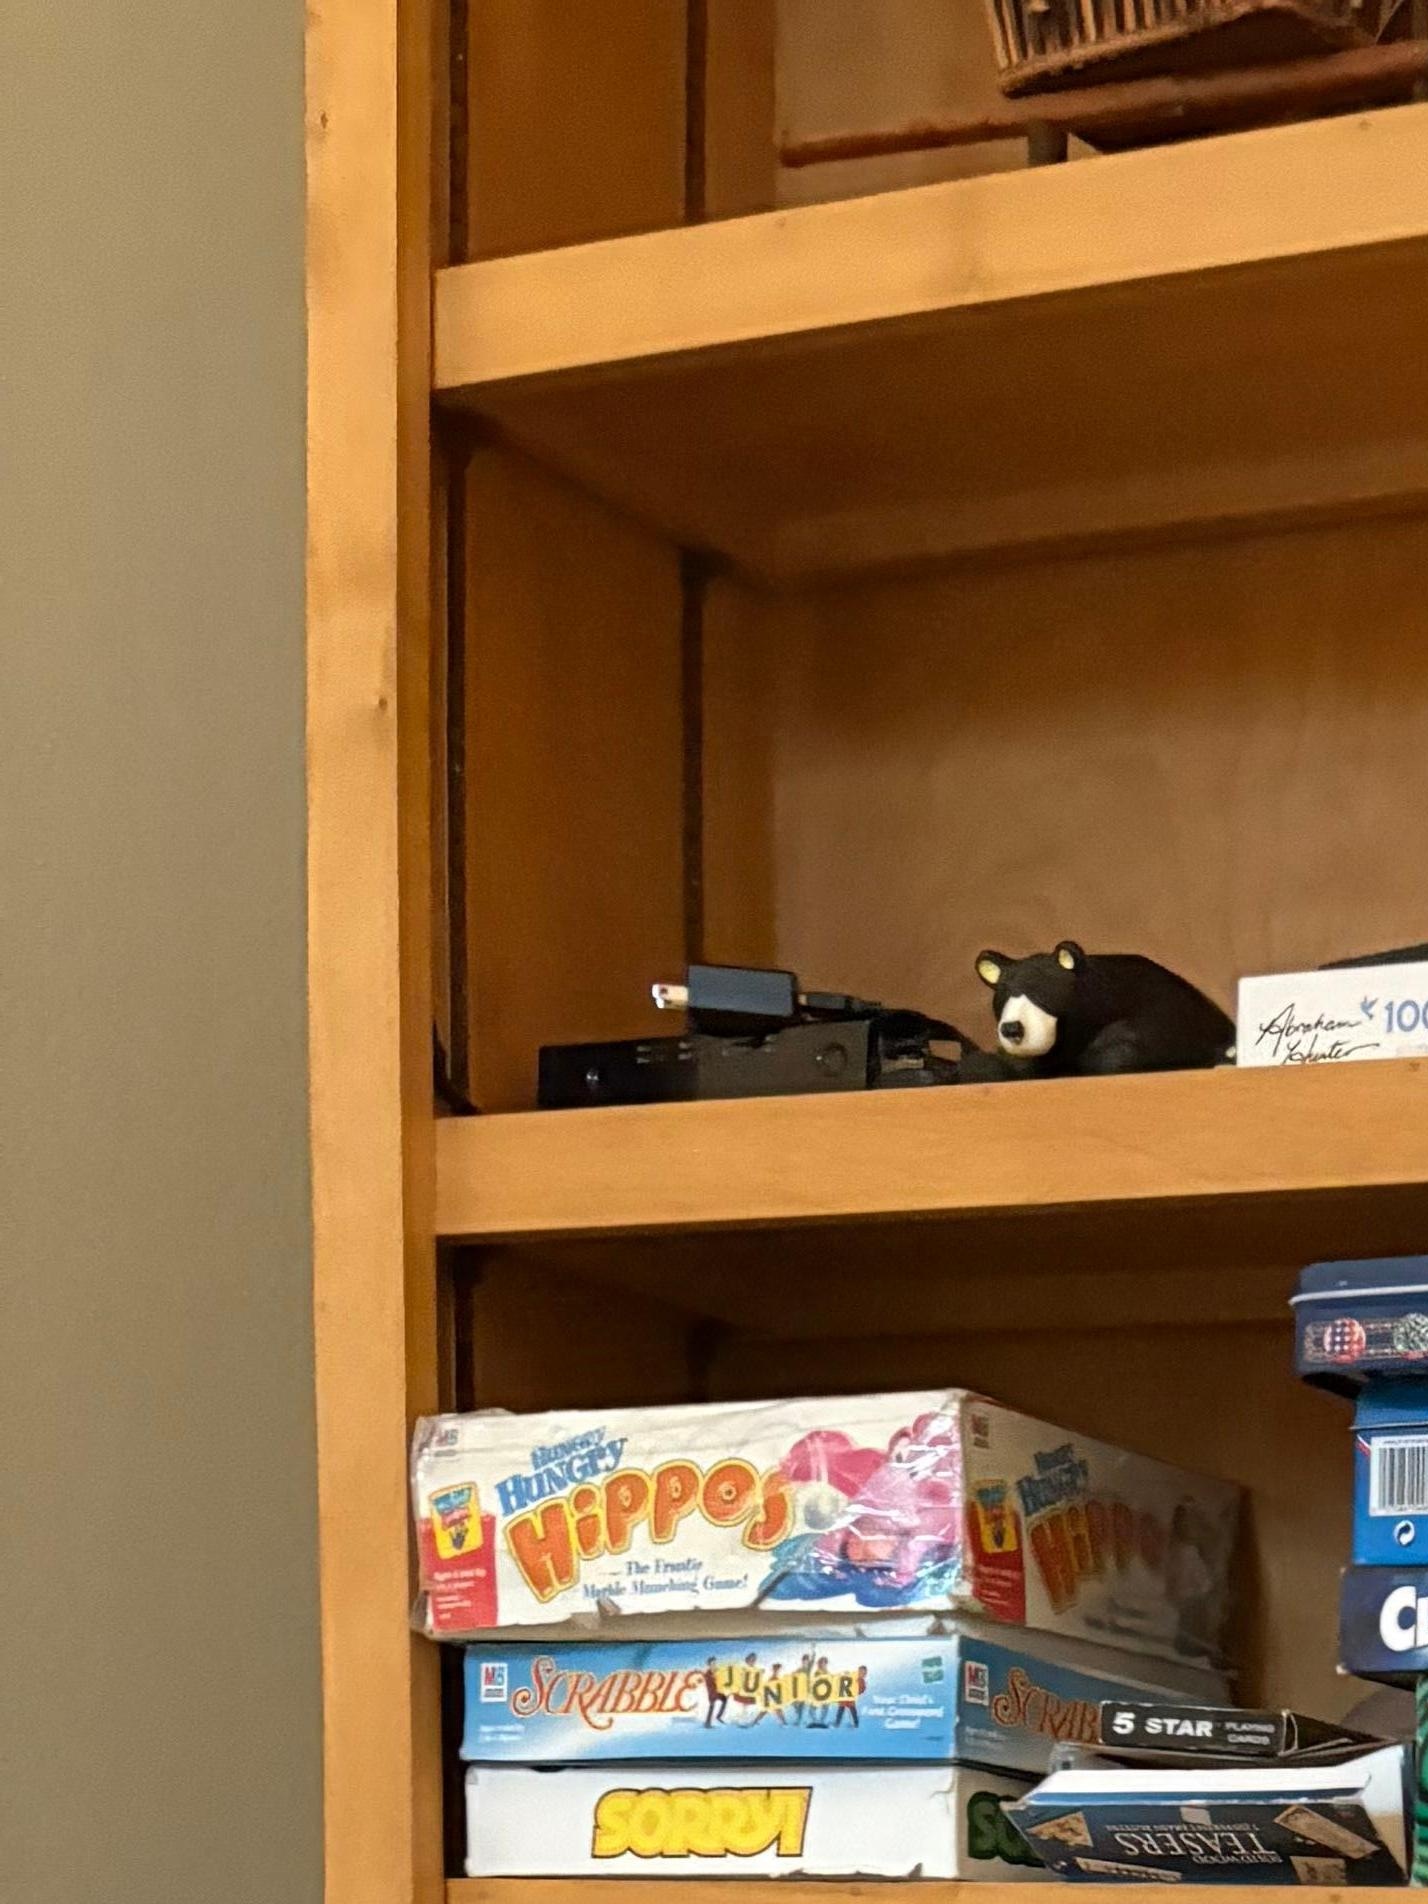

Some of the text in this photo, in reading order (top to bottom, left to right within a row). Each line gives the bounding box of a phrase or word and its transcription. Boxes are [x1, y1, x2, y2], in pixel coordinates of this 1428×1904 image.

[512, 1655, 854, 1730] SCRABBLE JUNIOR
[1112, 1712, 1213, 1738] 5 STAR
[592, 1787, 814, 1858] SORRY!
[1114, 1829, 1276, 1857] TEASERS
